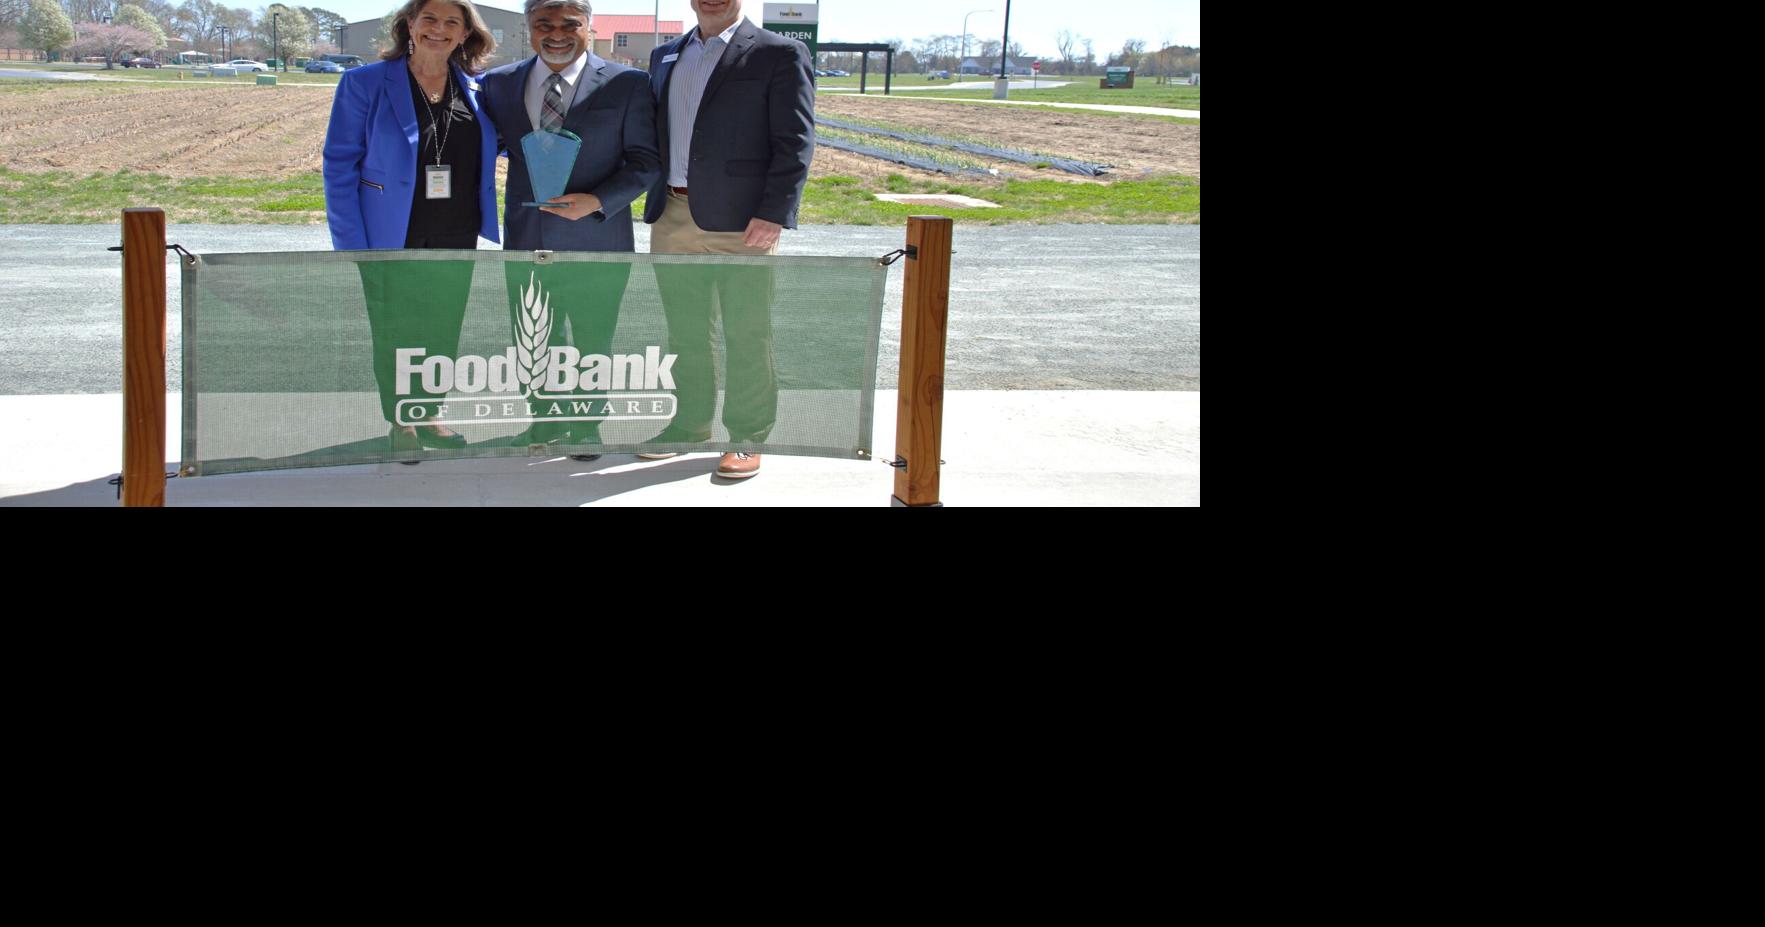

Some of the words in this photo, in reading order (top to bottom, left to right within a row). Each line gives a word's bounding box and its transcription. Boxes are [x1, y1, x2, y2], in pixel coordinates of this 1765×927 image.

[395, 346, 520, 395] Food
[544, 345, 678, 392] Bank
[407, 404, 450, 419] OF
[474, 400, 664, 418] DELAWARE
